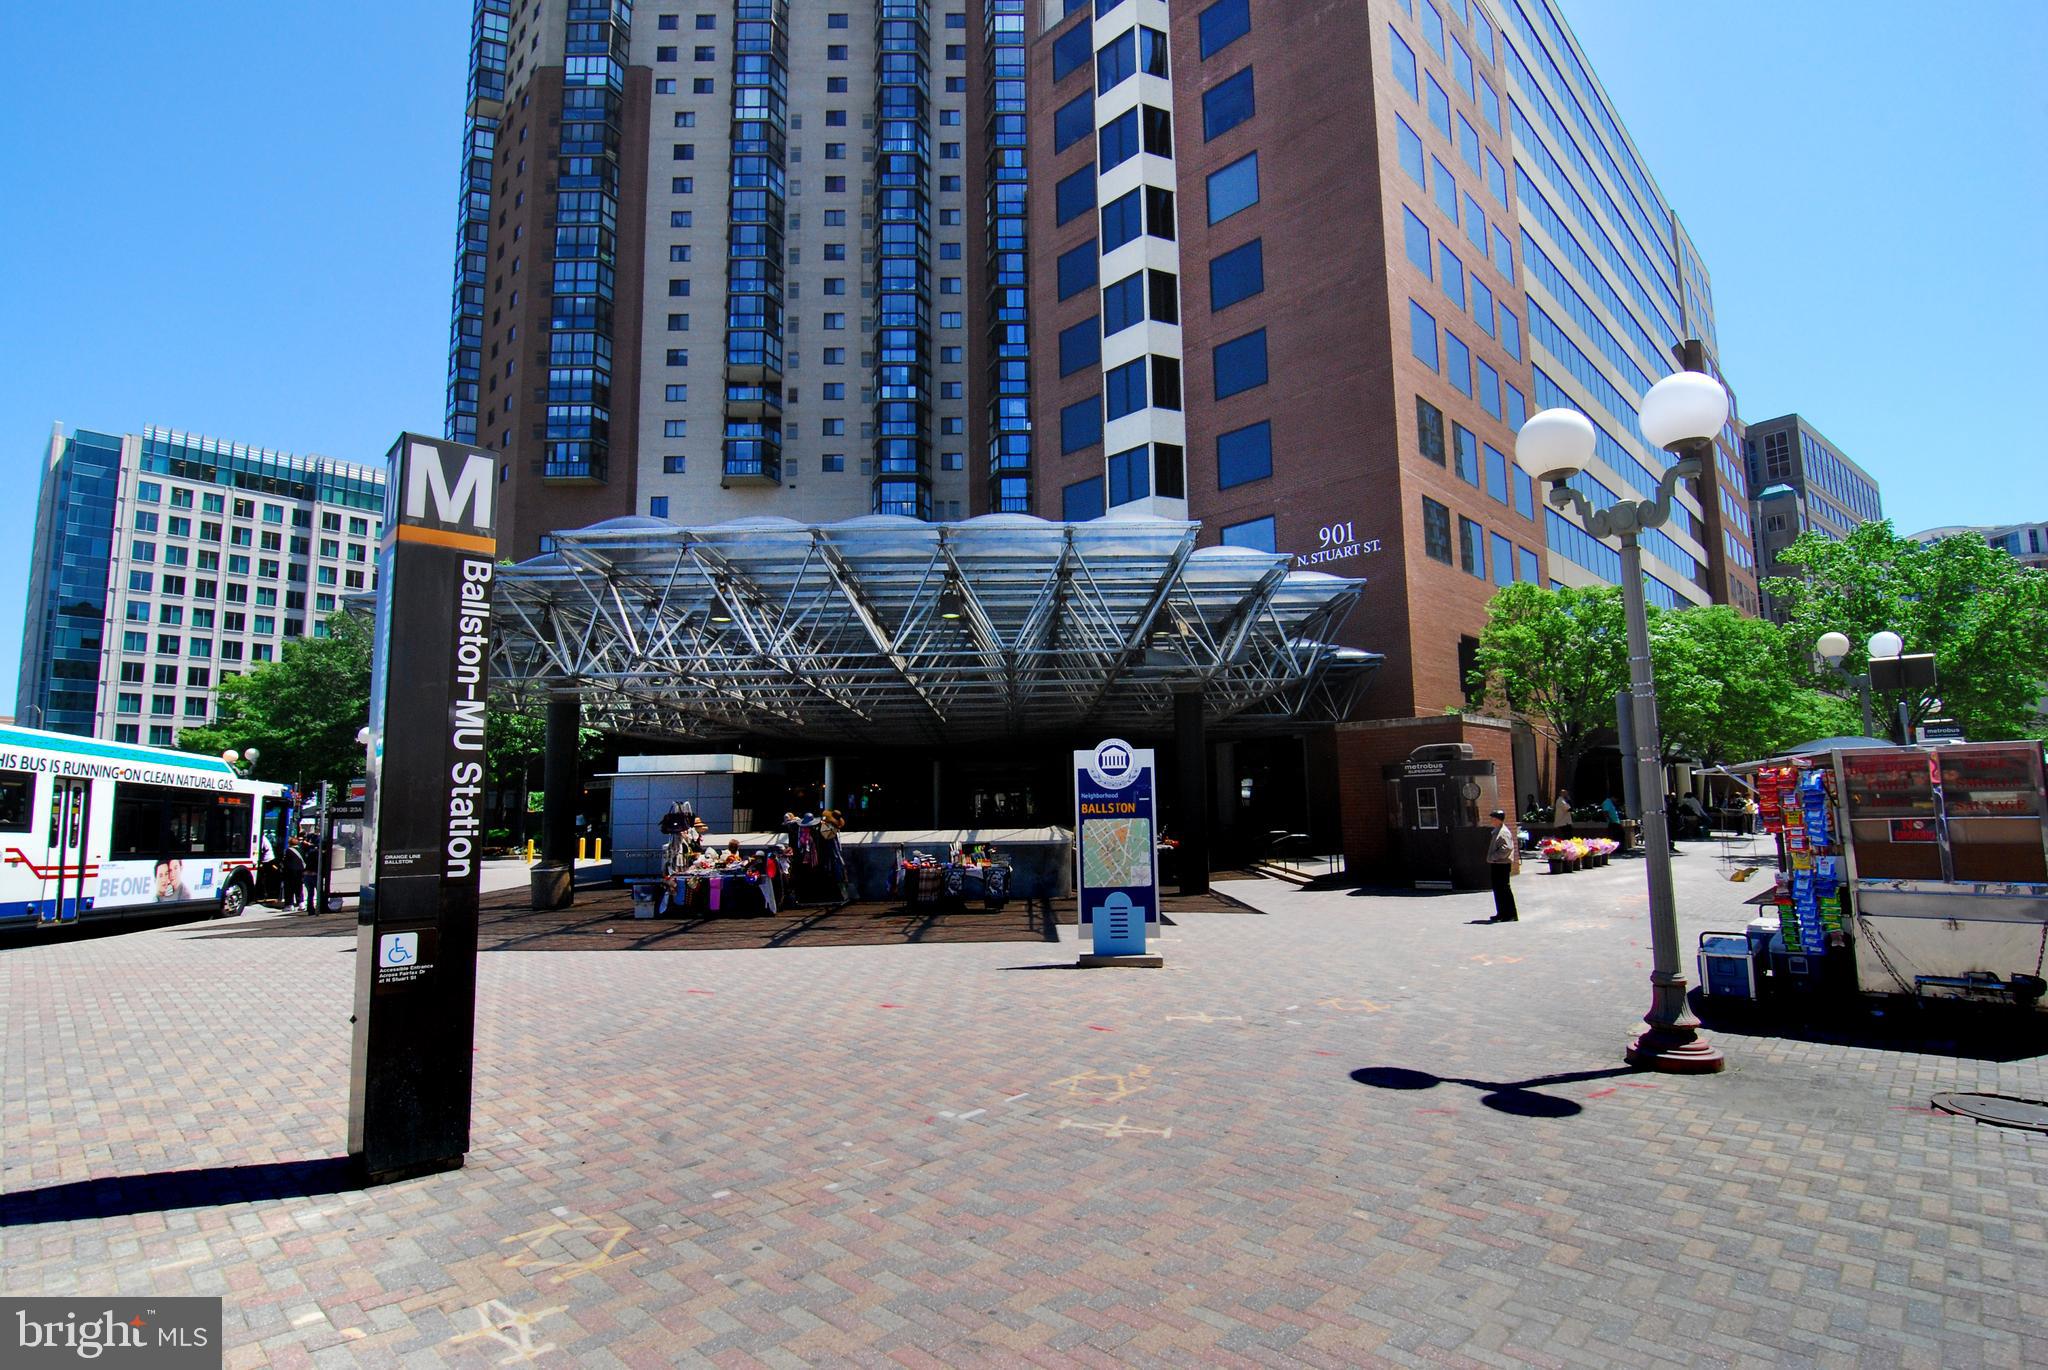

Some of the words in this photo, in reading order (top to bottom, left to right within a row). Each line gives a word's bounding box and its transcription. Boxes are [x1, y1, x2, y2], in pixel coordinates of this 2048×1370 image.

[406, 443, 493, 529] M
[1319, 521, 1354, 548] 901
[1297, 555, 1310, 567] N.
[1310, 543, 1360, 564] STUART
[1363, 539, 1382, 553] ST.
[1927, 727, 1960, 735] metrobus
[20, 756, 47, 771] BUS
[49, 760, 61, 773] IS
[63, 761, 120, 779] RUNNING
[123, 768, 141, 781] ON
[143, 770, 175, 785] CLEAN
[176, 774, 215, 789] NATURAL
[1404, 762, 1443, 770] metrobus
[1080, 792, 1119, 800] Neighborhood
[1081, 803, 1136, 814] BALLSTON
[447, 762, 482, 878] Station
[99, 879, 119, 897] BE
[121, 876, 151, 896] ONE
[379, 971, 398, 979] Across
